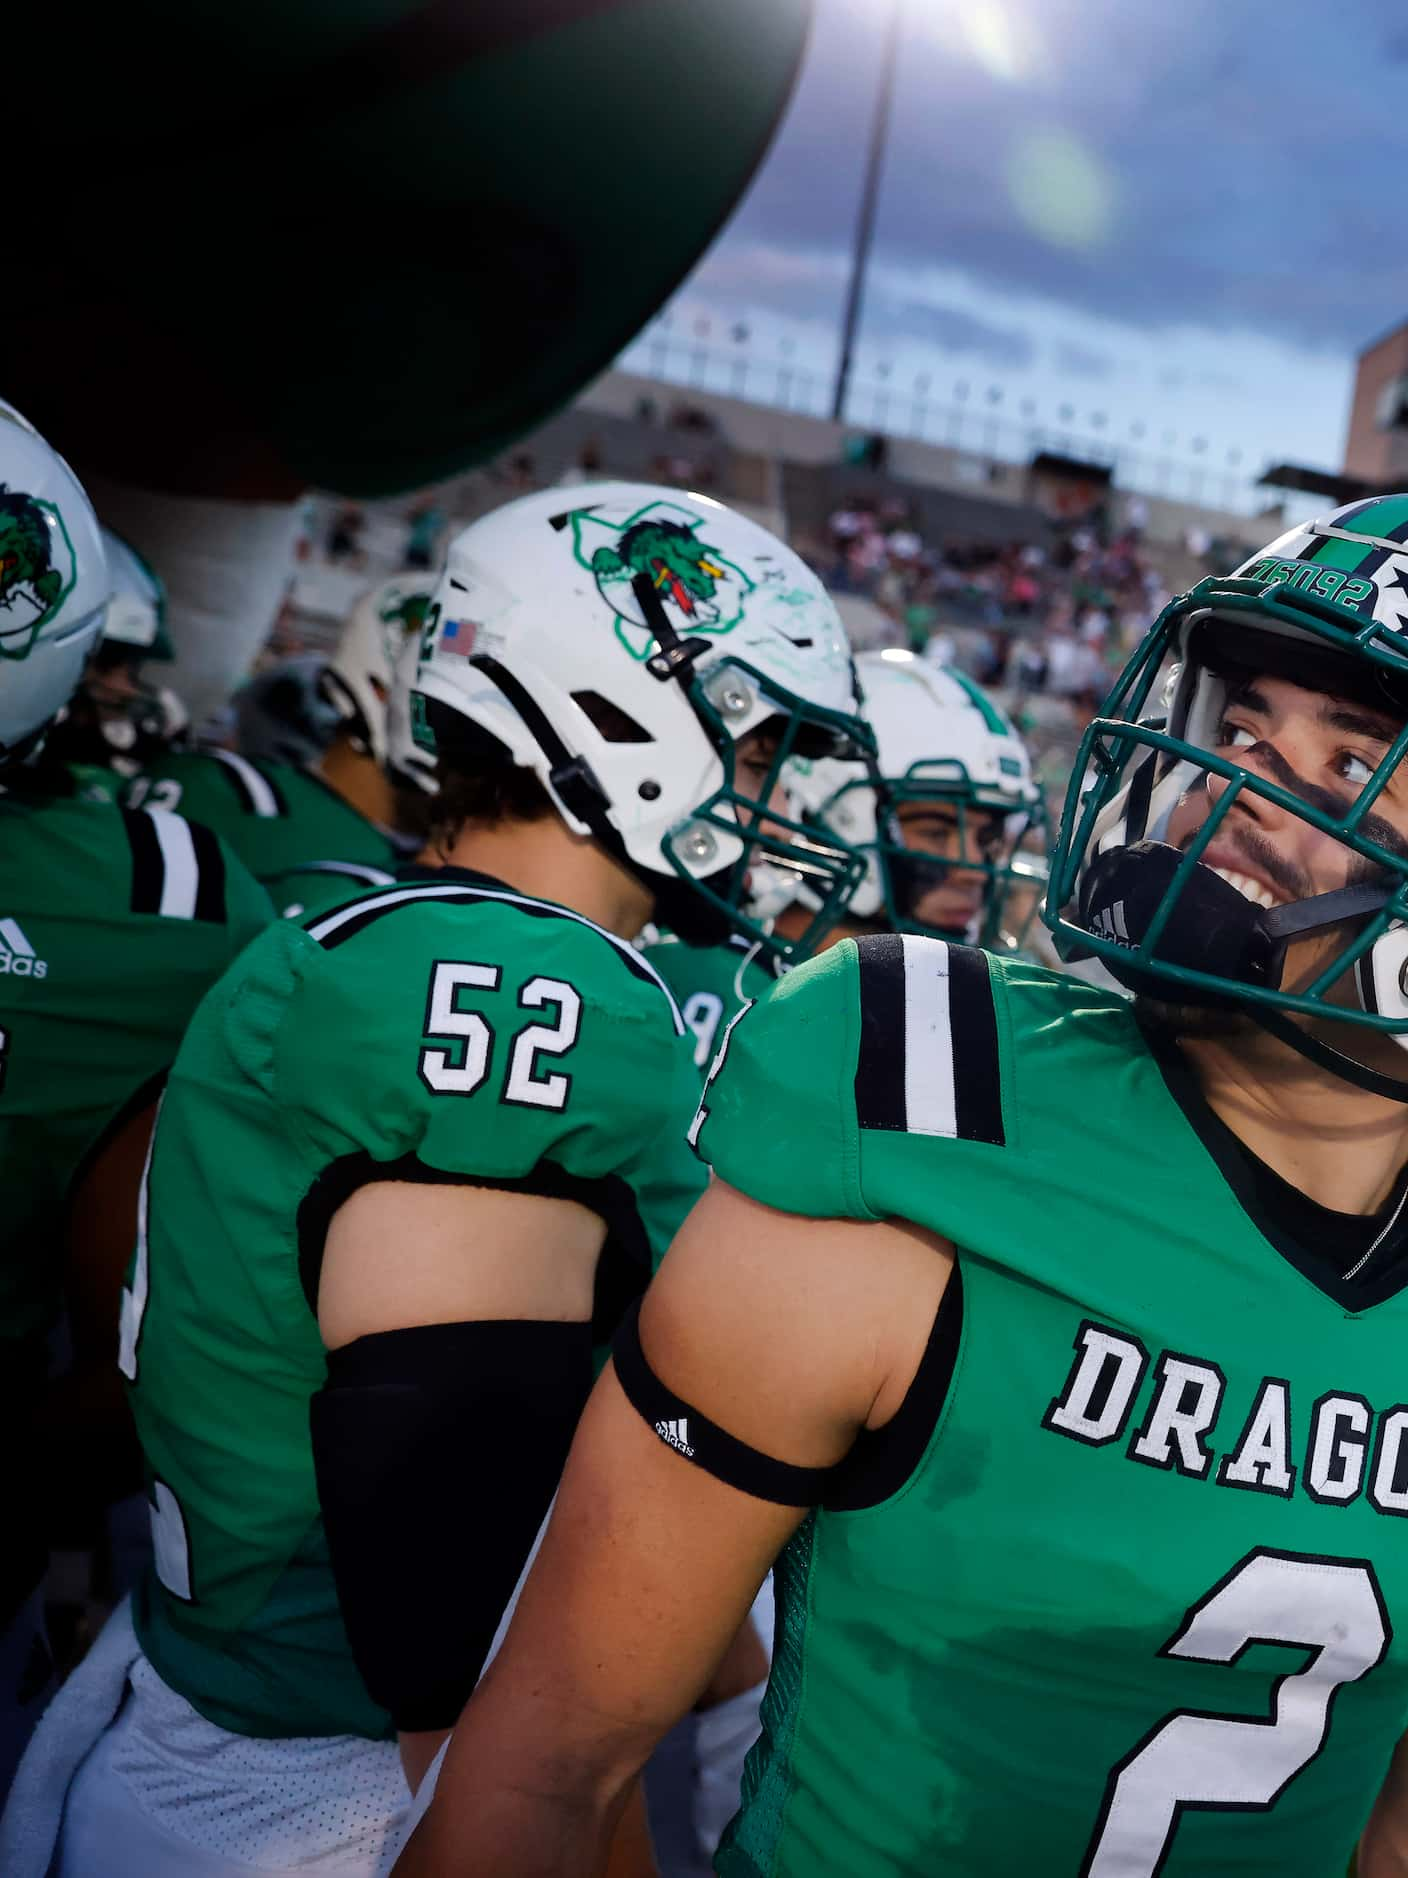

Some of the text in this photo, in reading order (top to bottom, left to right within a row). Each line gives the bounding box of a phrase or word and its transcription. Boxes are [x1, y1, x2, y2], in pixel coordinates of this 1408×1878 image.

[1252, 558, 1374, 612] 76092
[0, 953, 48, 979] das
[416, 959, 585, 1113] 52
[655, 1422, 695, 1457] adidas
[1077, 1545, 1394, 1878] 2
